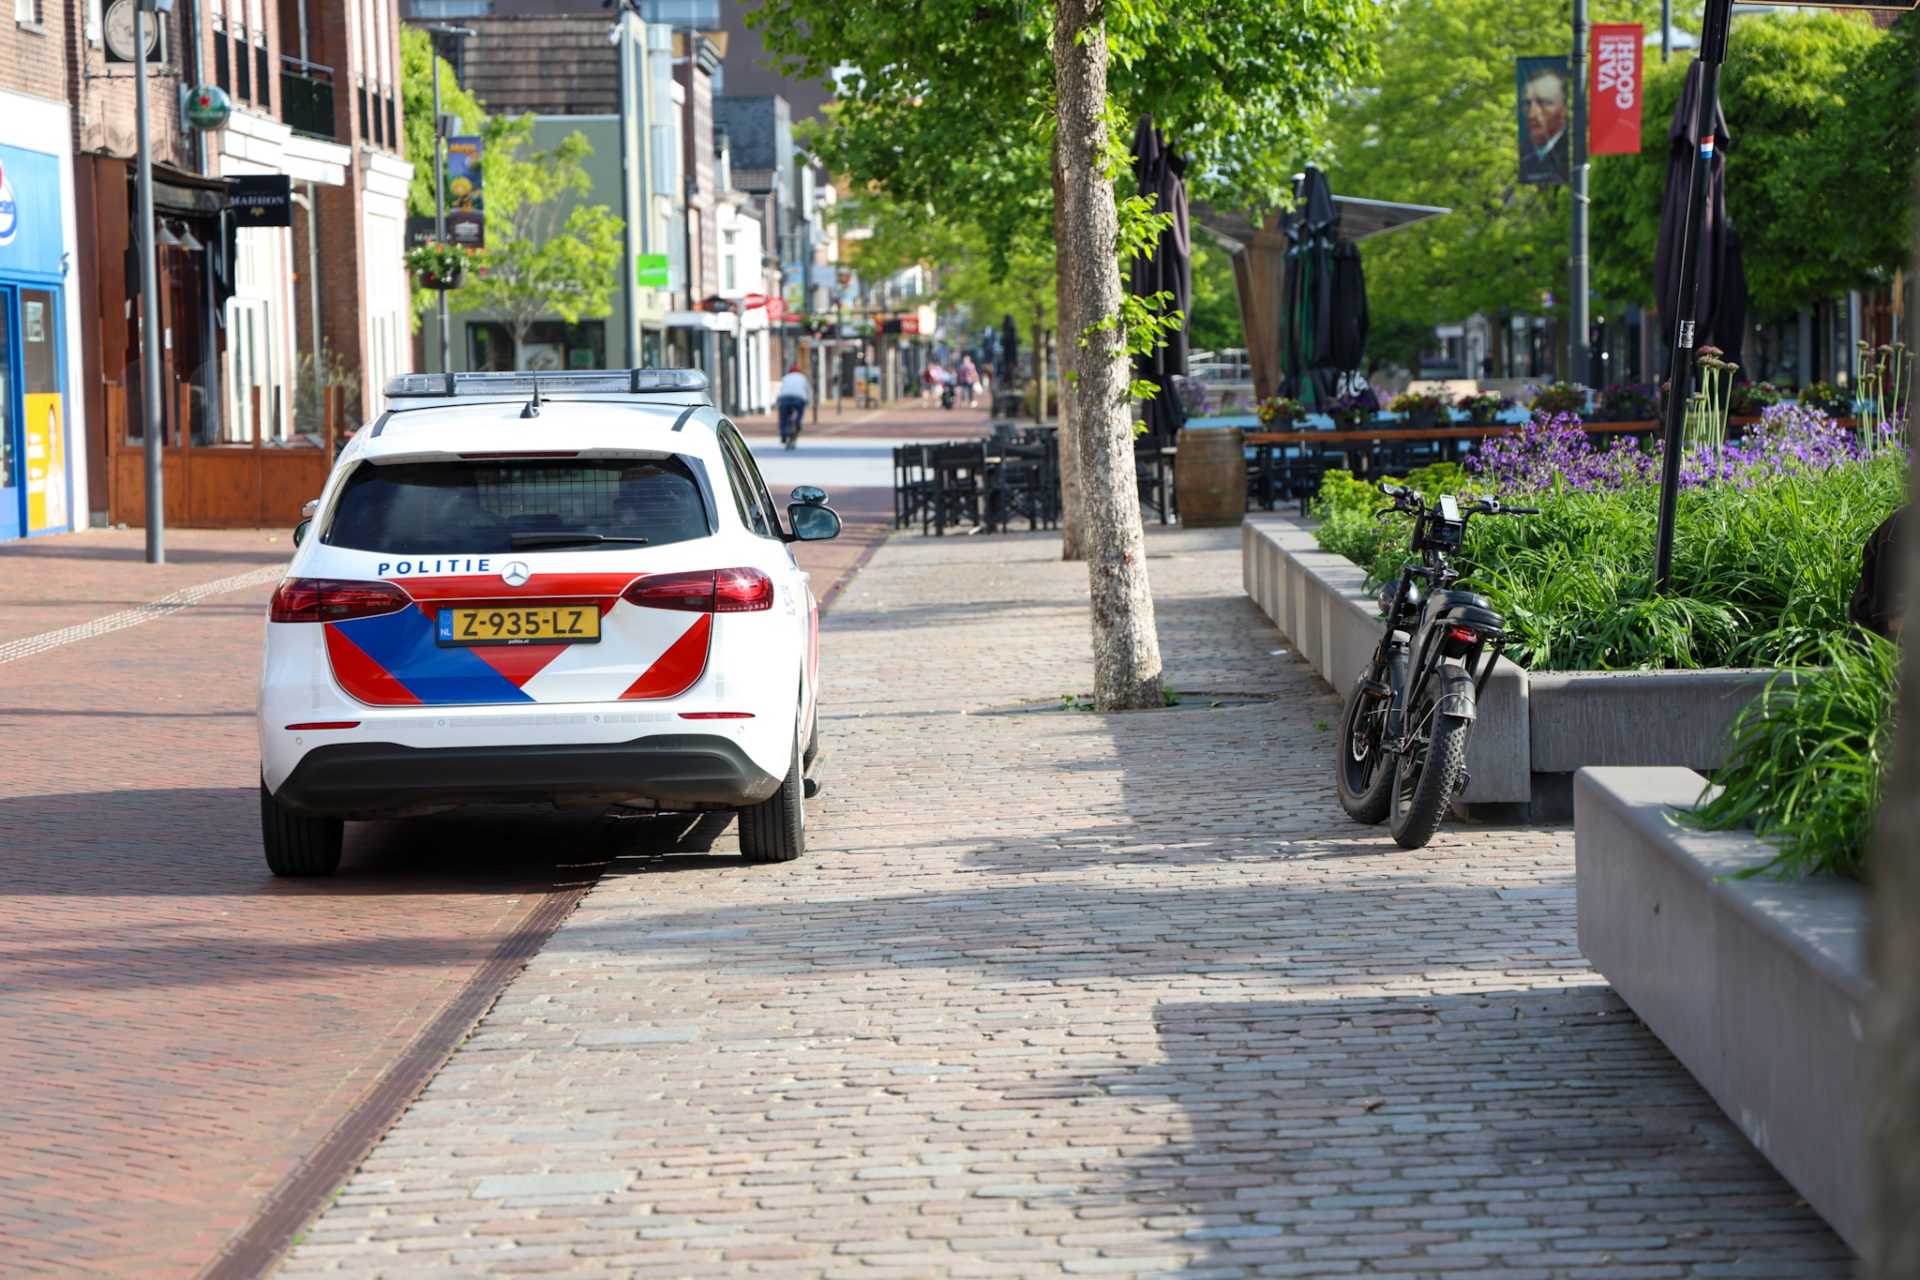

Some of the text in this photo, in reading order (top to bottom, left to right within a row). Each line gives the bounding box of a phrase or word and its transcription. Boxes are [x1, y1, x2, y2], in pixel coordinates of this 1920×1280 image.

[1598, 43, 1616, 92] VAN
[1615, 43, 1635, 109] GOGH
[378, 559, 491, 576] POLITIE
[440, 628, 452, 637] NL
[462, 611, 583, 637] Z-935-LZ
